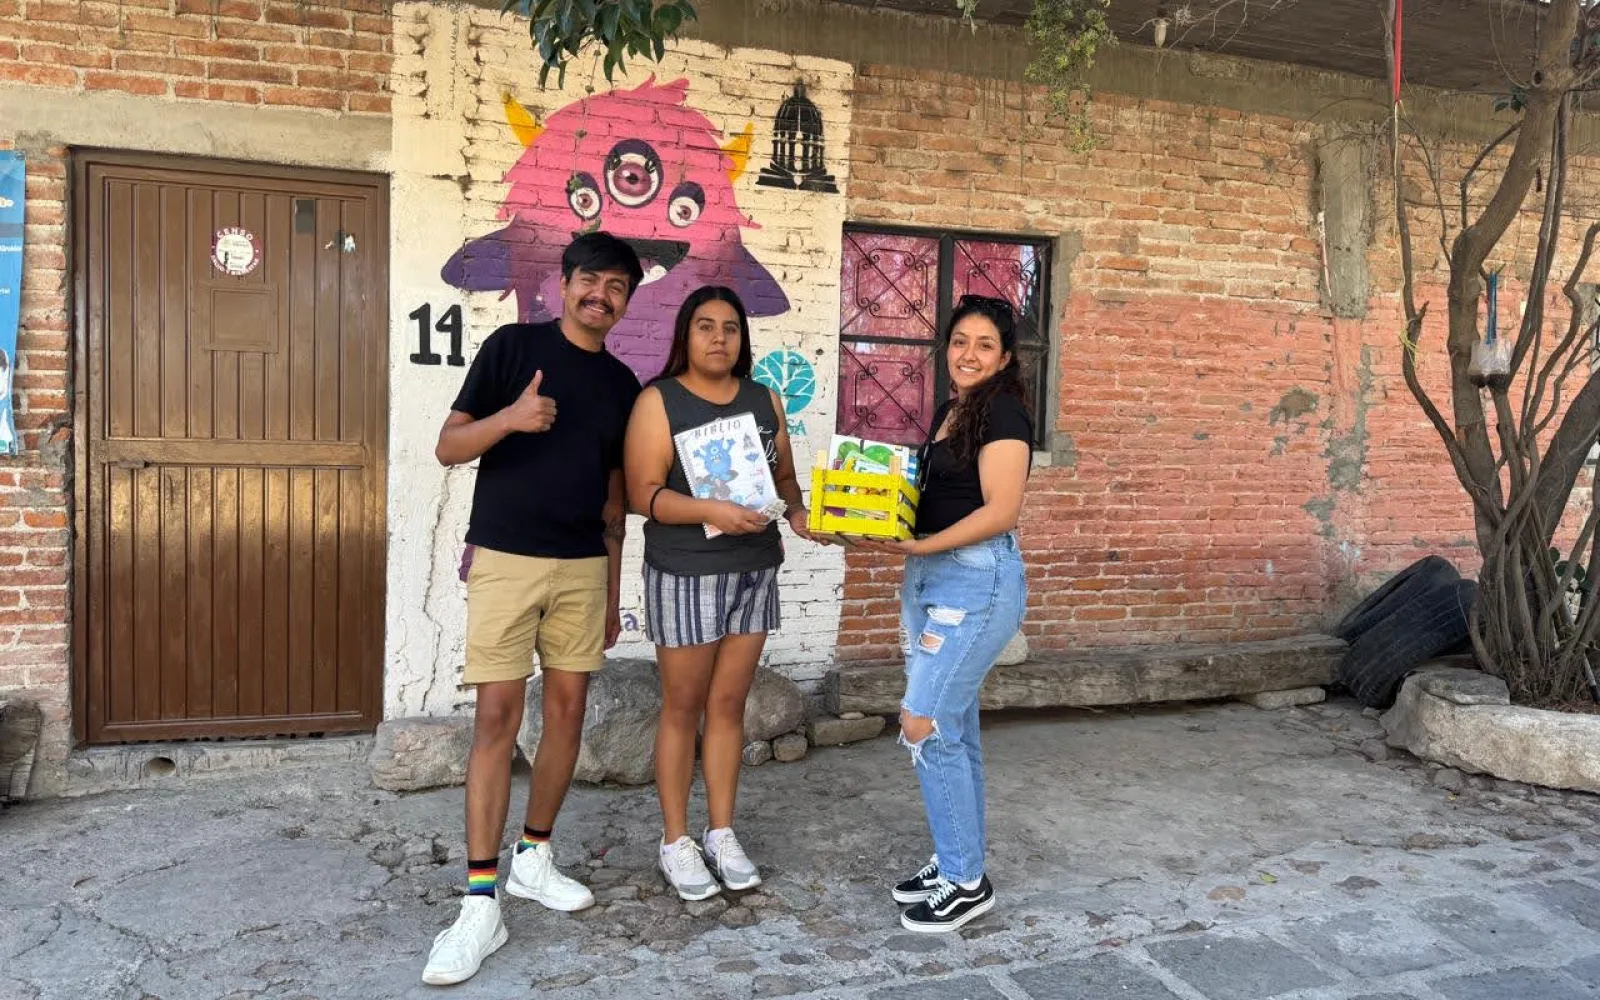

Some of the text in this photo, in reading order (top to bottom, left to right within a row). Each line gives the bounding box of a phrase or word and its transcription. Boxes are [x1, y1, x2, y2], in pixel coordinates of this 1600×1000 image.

[216, 227, 254, 241] CENSO
[408, 302, 466, 367] 14
[693, 418, 741, 439] BIBLIO
